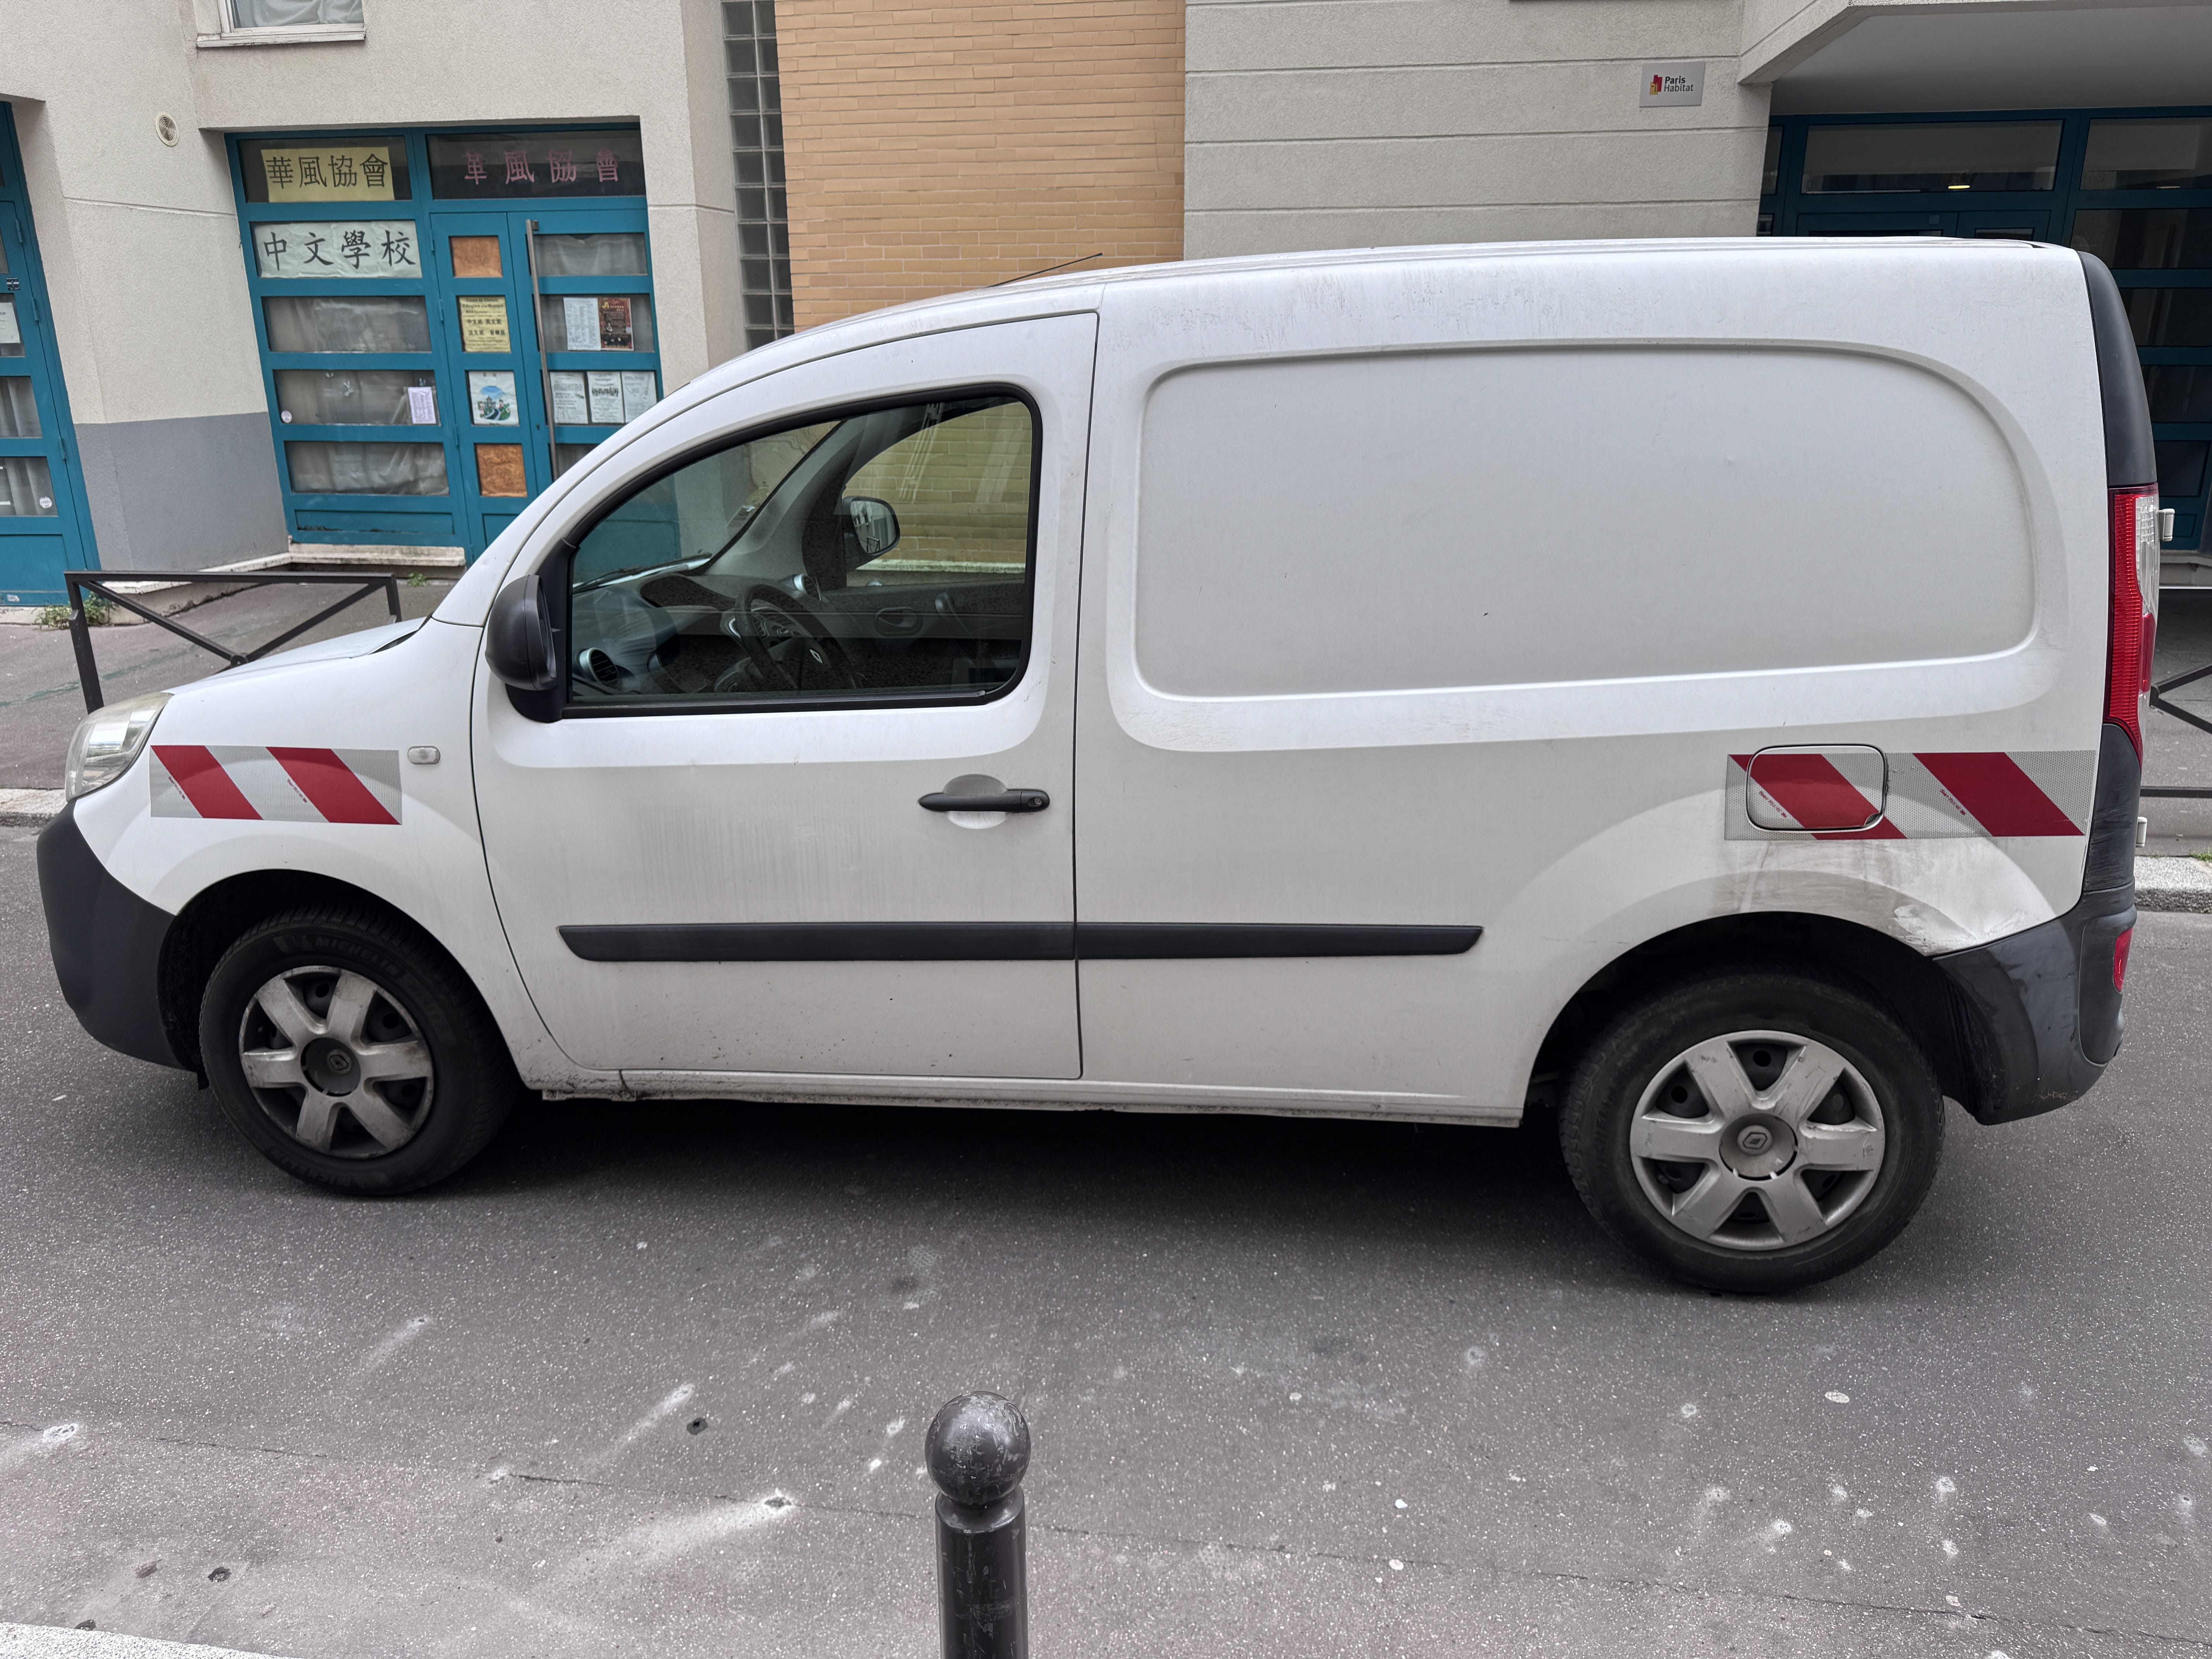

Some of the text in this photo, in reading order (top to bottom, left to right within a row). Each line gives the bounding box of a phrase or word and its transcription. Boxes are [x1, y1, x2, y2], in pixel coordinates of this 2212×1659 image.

[1664, 84, 1693, 92] Habitat
[1665, 75, 1686, 84] Paris
[266, 153, 388, 189] 華風協會
[264, 230, 416, 271] 中文學校
[315, 936, 401, 978] MICHELIN
